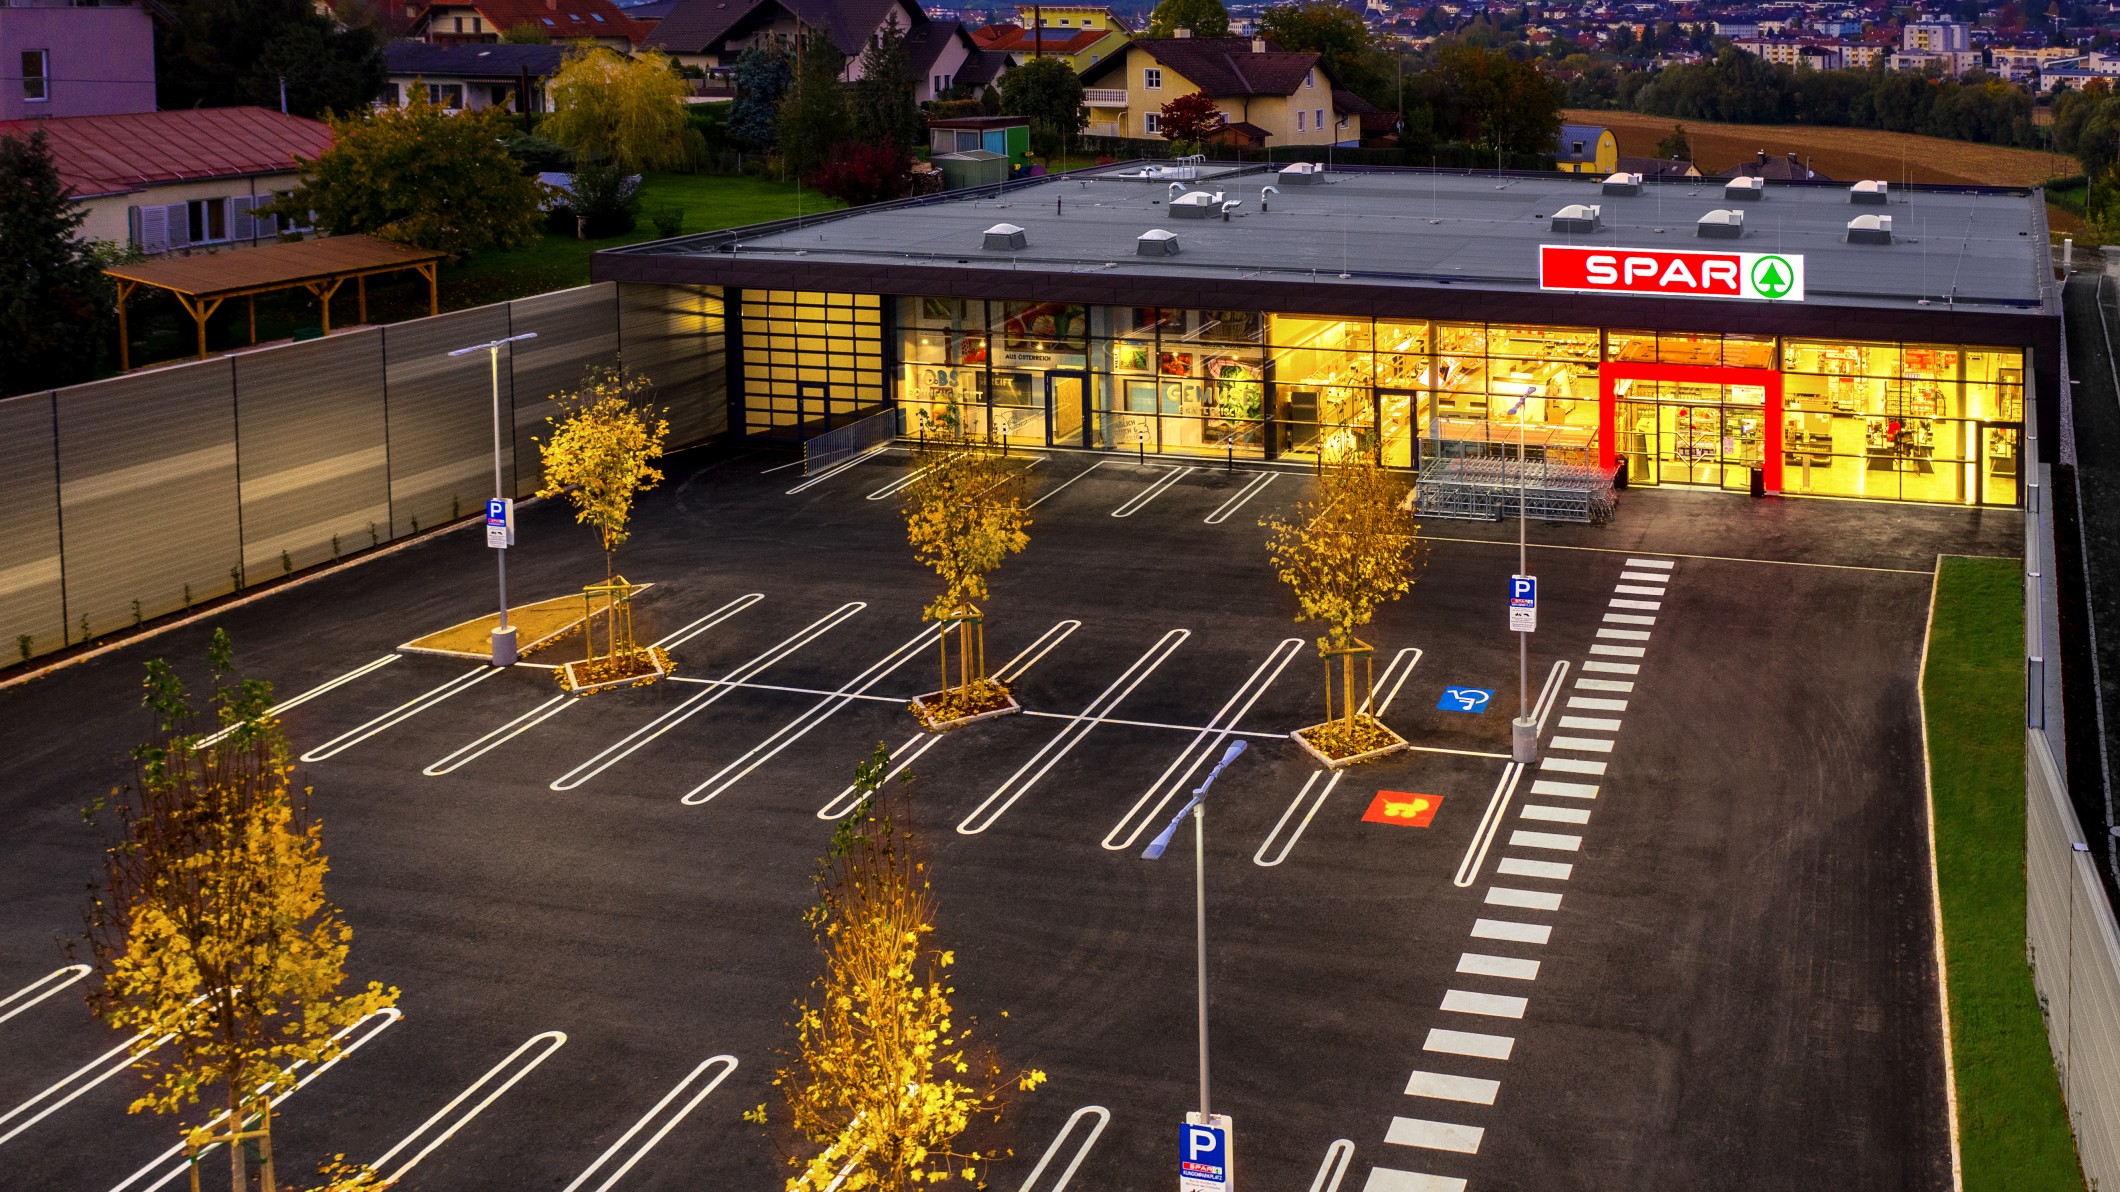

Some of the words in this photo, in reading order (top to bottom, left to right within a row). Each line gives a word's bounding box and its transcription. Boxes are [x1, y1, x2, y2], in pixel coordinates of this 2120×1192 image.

[1586, 255, 1738, 290] SPAR
[1018, 353, 1052, 362] ÖSTERREICH
[921, 369, 973, 388] OBST
[490, 503, 502, 517] P
[1515, 581, 1530, 597] P
[1189, 1128, 1217, 1160] P
[1189, 1163, 1213, 1172] SPAR
